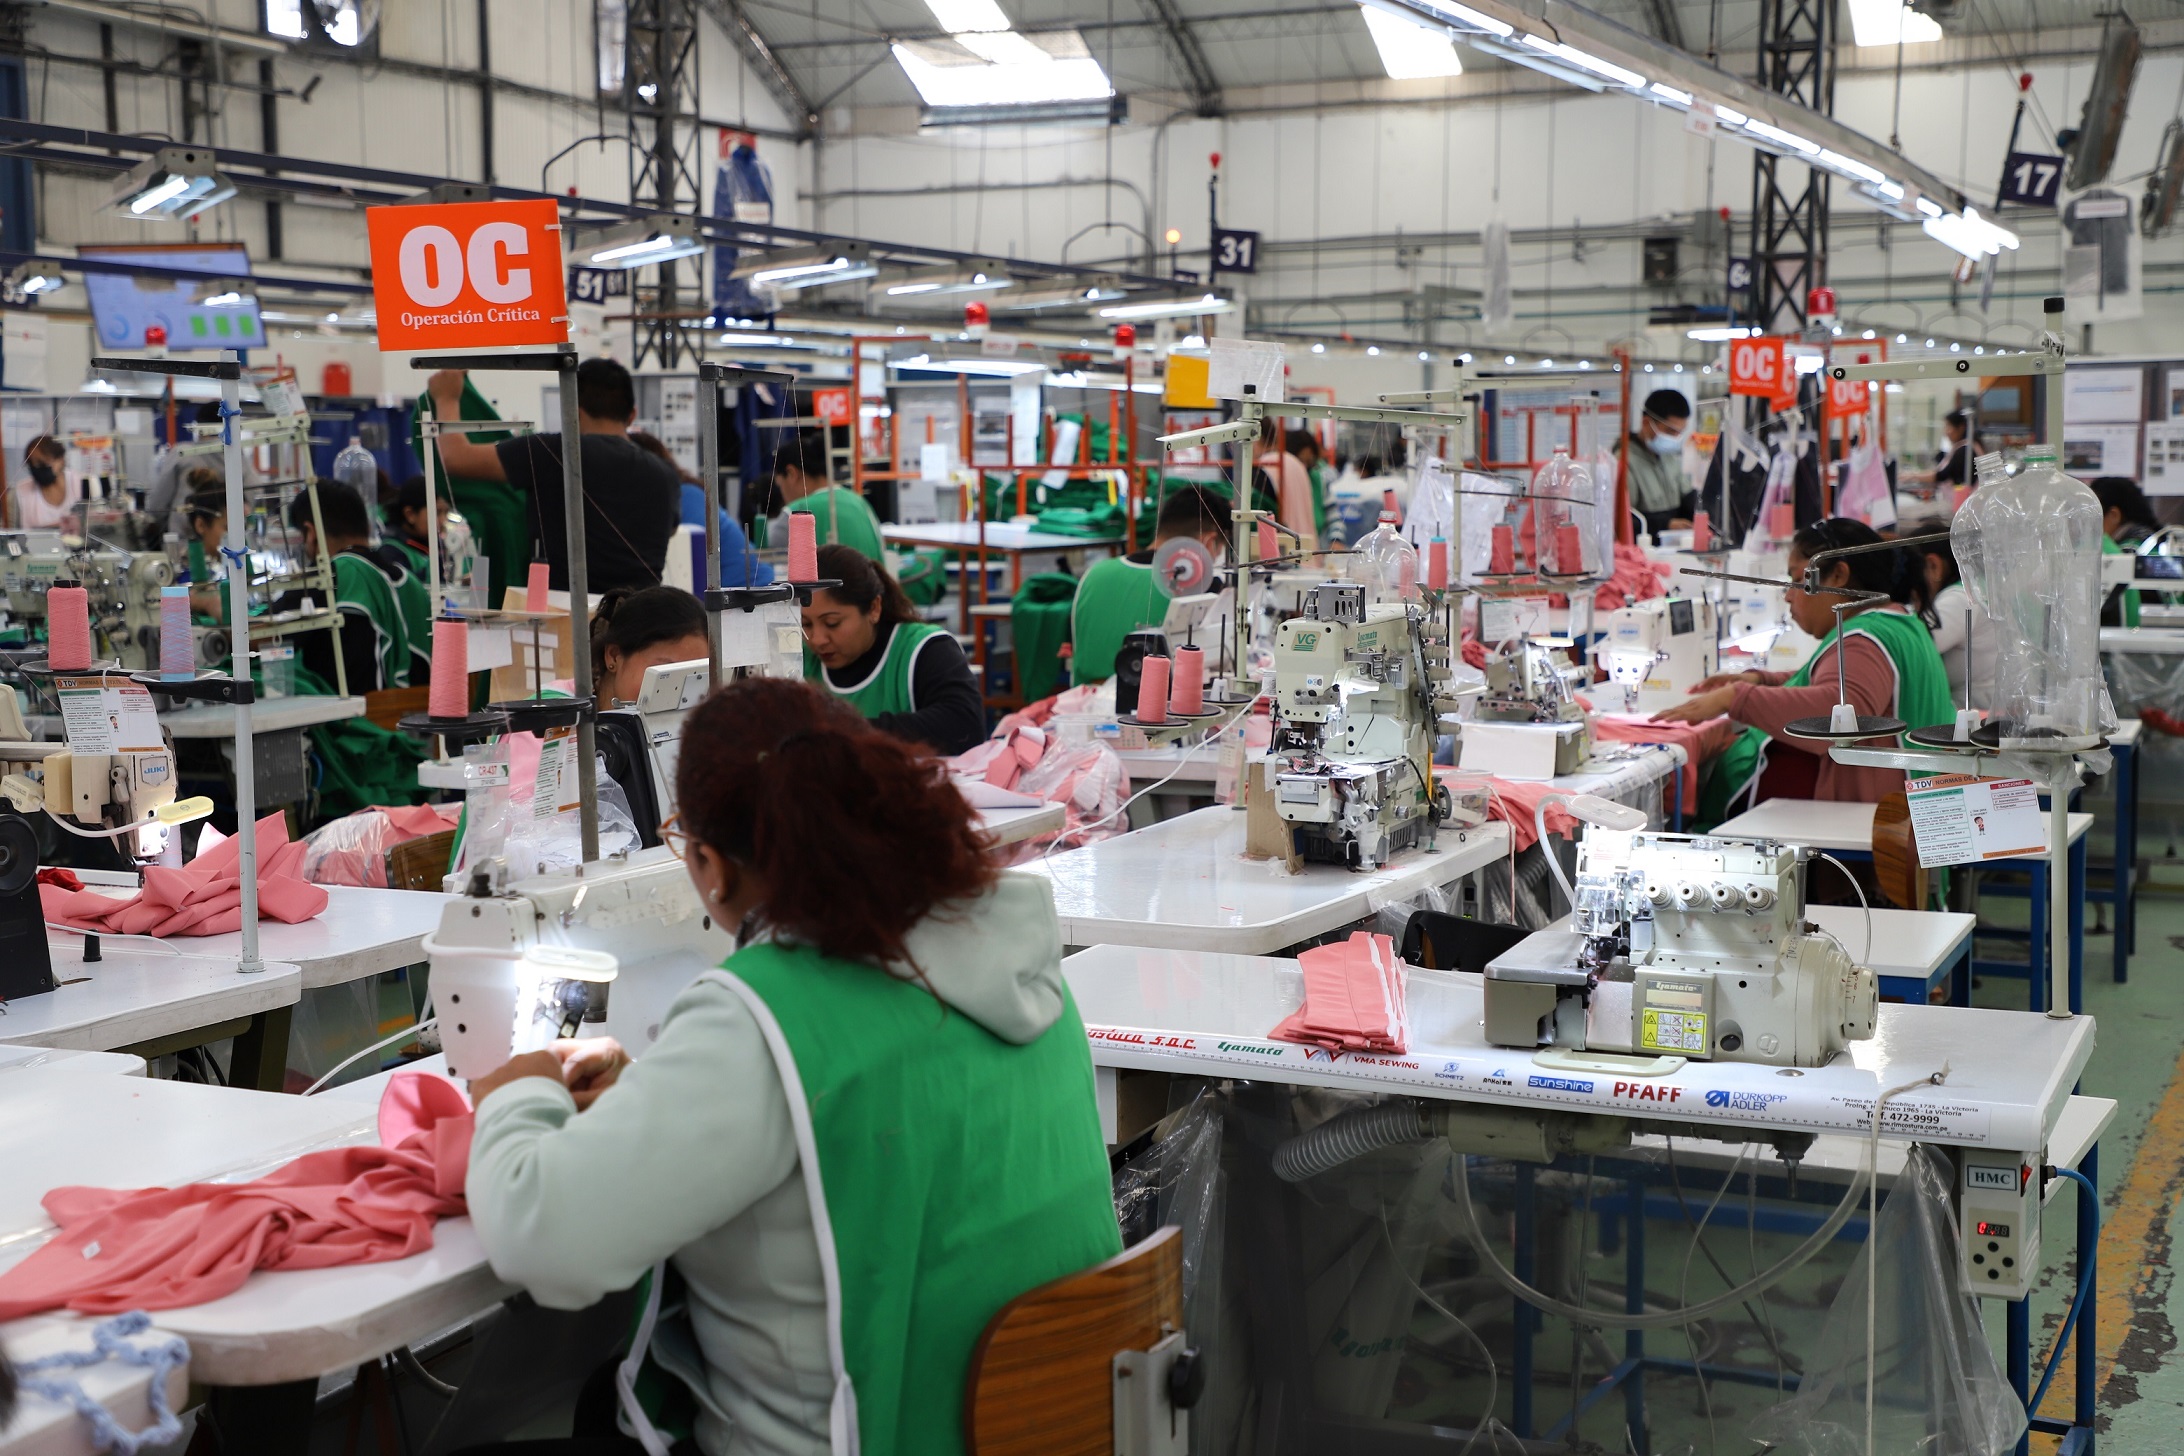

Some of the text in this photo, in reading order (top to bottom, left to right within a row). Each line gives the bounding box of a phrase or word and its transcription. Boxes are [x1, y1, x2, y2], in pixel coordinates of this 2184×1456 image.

[2014, 161, 2057, 197] 17
[1218, 235, 1252, 267] 31
[398, 221, 533, 308] OC
[576, 270, 604, 300] 51
[401, 307, 540, 330] Operación Crítica
[1735, 345, 1775, 381] OC
[1833, 380, 1865, 406] OC
[818, 392, 847, 416] OC
[1297, 633, 1317, 645] VG
[144, 765, 166, 774] JUKI
[1915, 780, 1932, 789] TDV
[1935, 777, 1962, 786] NORMAS
[1354, 1055, 1420, 1070] VMA SEWING
[1434, 1072, 1465, 1081] SCHMETZ
[1529, 1077, 1593, 1092] sunshine
[1613, 1082, 1682, 1103] PFAFF
[1731, 1101, 1767, 1112] ADLER
[1870, 1104, 1901, 1112] Hnuco
[1934, 1109, 1962, 1117] Victoria
[1865, 1110, 1940, 1125] Tef. 472-9999
[1879, 1121, 1948, 1132] ww.rimcostura.com.pe
[1975, 1171, 2011, 1185] HMC
